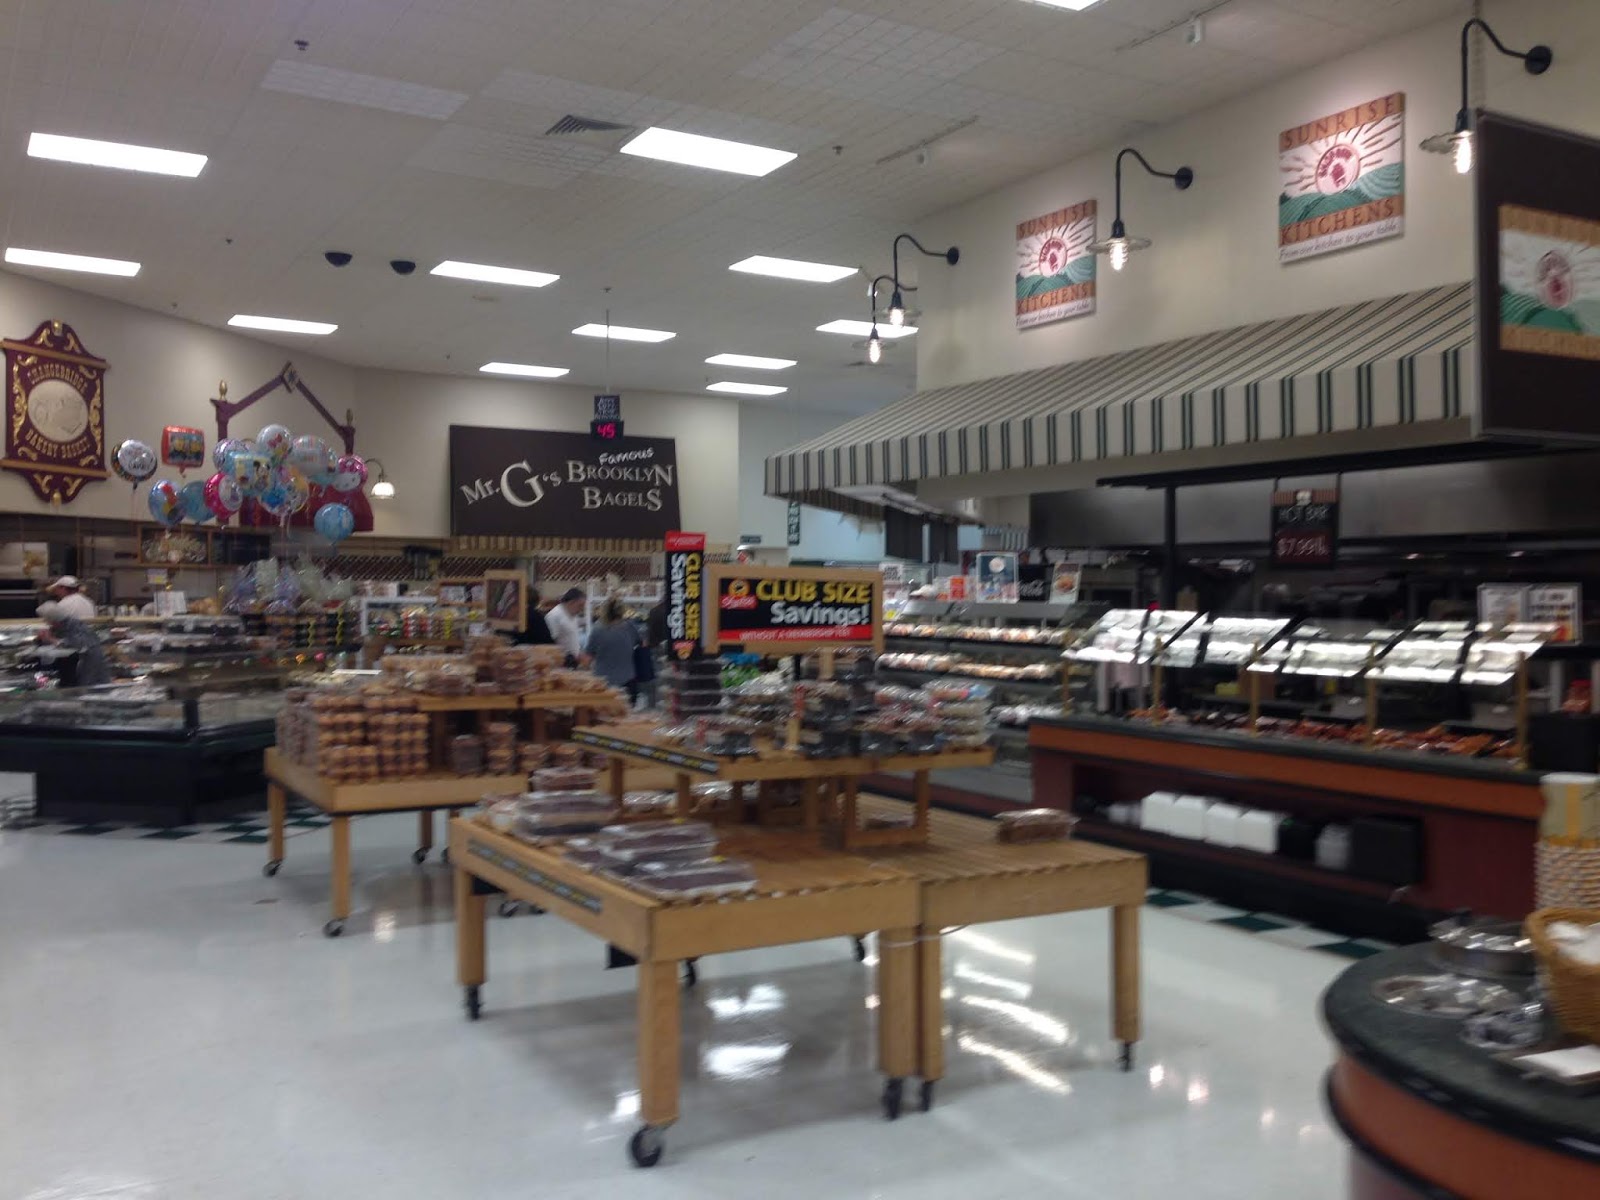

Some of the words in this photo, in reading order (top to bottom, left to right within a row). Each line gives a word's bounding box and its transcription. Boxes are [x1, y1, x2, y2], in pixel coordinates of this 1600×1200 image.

[1284, 97, 1396, 147] SUNRISE
[1019, 203, 1088, 239] SUNRISE
[1280, 198, 1394, 245] KITCHENS
[1017, 282, 1088, 316] KITCHENS
[598, 447, 655, 466] Famous
[460, 477, 501, 505] Mr.
[685, 552, 701, 599] CLUB
[756, 578, 817, 602] CLUB
[823, 580, 871, 604] SIZE
[685, 602, 701, 641] SIZE
[770, 600, 871, 628] Savings!
